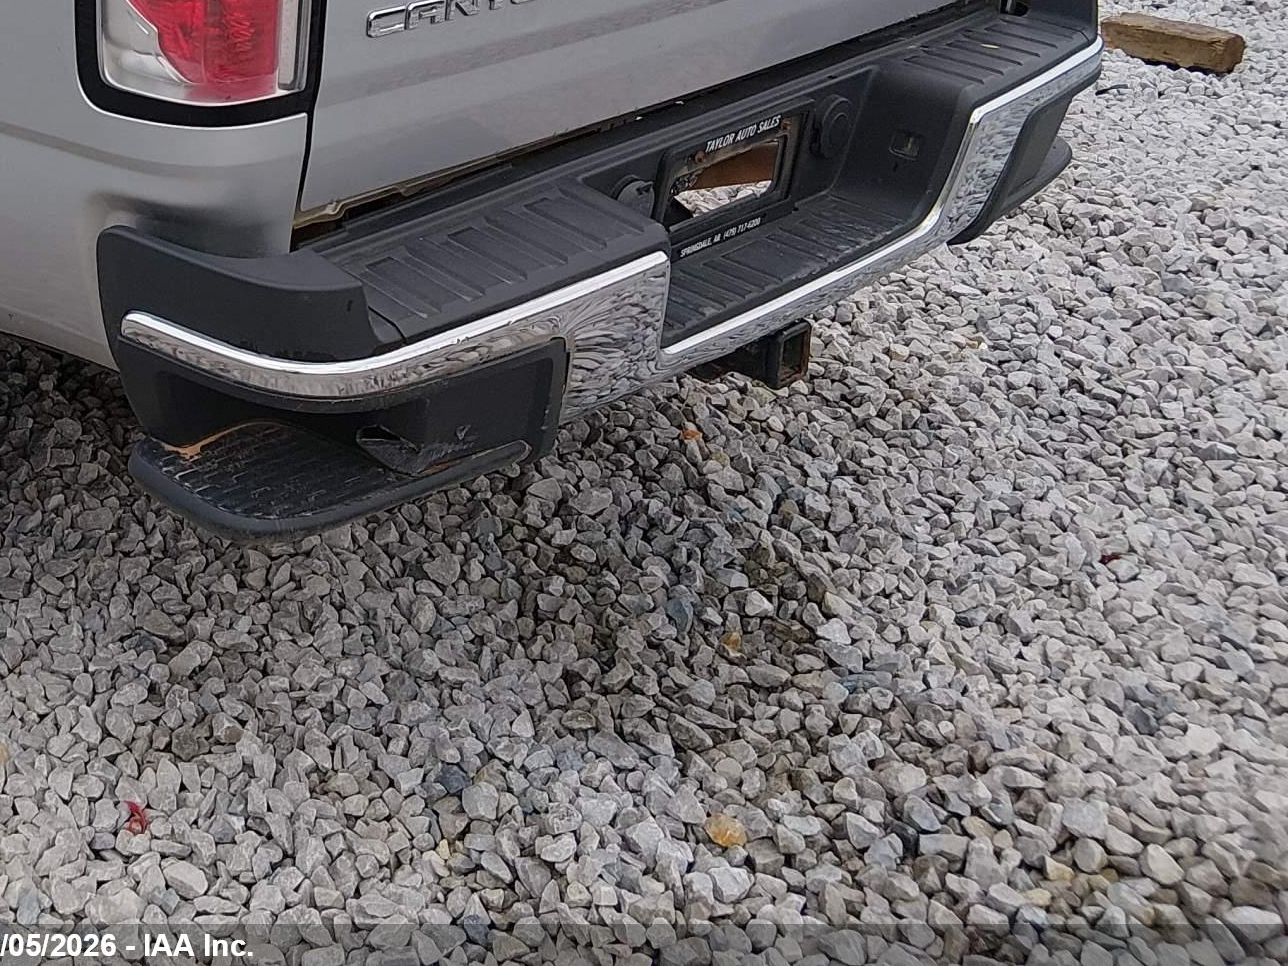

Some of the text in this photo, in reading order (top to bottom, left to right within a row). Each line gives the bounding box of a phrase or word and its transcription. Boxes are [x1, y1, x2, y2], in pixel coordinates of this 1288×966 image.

[705, 114, 782, 153] TAYLOR AUTO SALES
